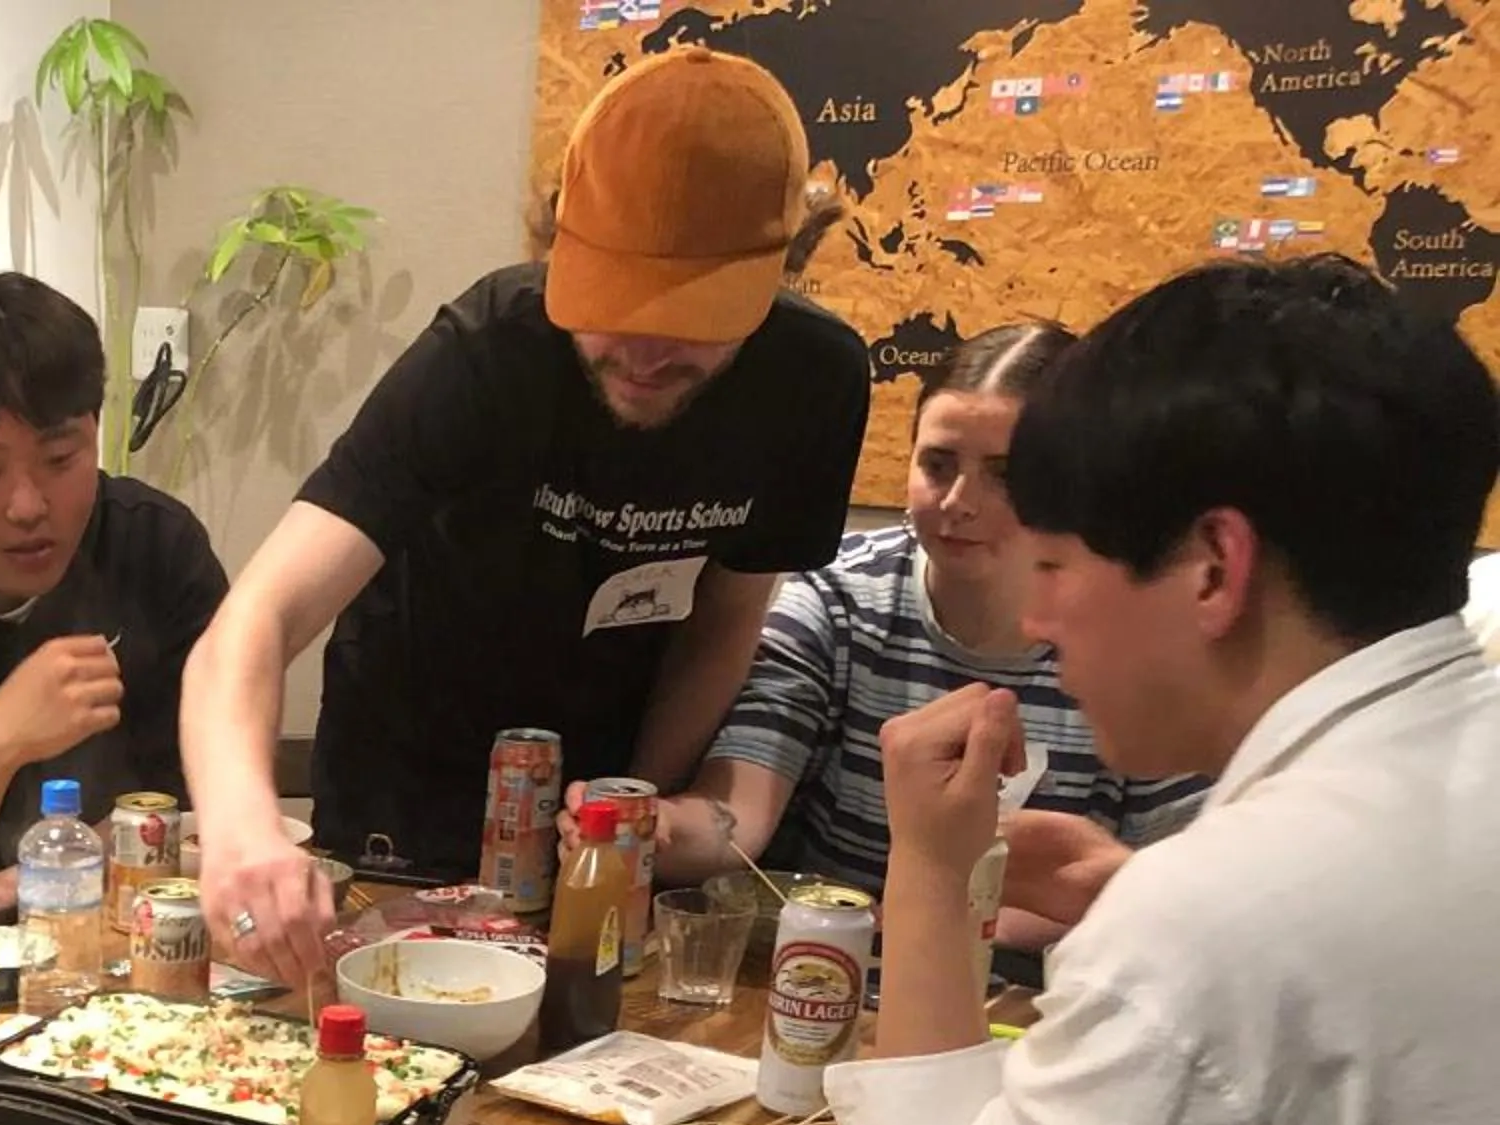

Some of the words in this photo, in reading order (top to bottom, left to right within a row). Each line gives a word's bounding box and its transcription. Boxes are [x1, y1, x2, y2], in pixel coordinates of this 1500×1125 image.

[1262, 38, 1332, 65] North
[1260, 67, 1362, 93] America
[816, 96, 877, 124] Asia
[1002, 151, 1073, 174] Pacific
[1084, 154, 1161, 173] Ocean
[1392, 228, 1466, 251] South
[1389, 256, 1494, 278] America
[878, 344, 949, 366] Ocean
[616, 503, 684, 538] Sports
[686, 499, 754, 530] School
[803, 1003, 857, 1021] LAGER
